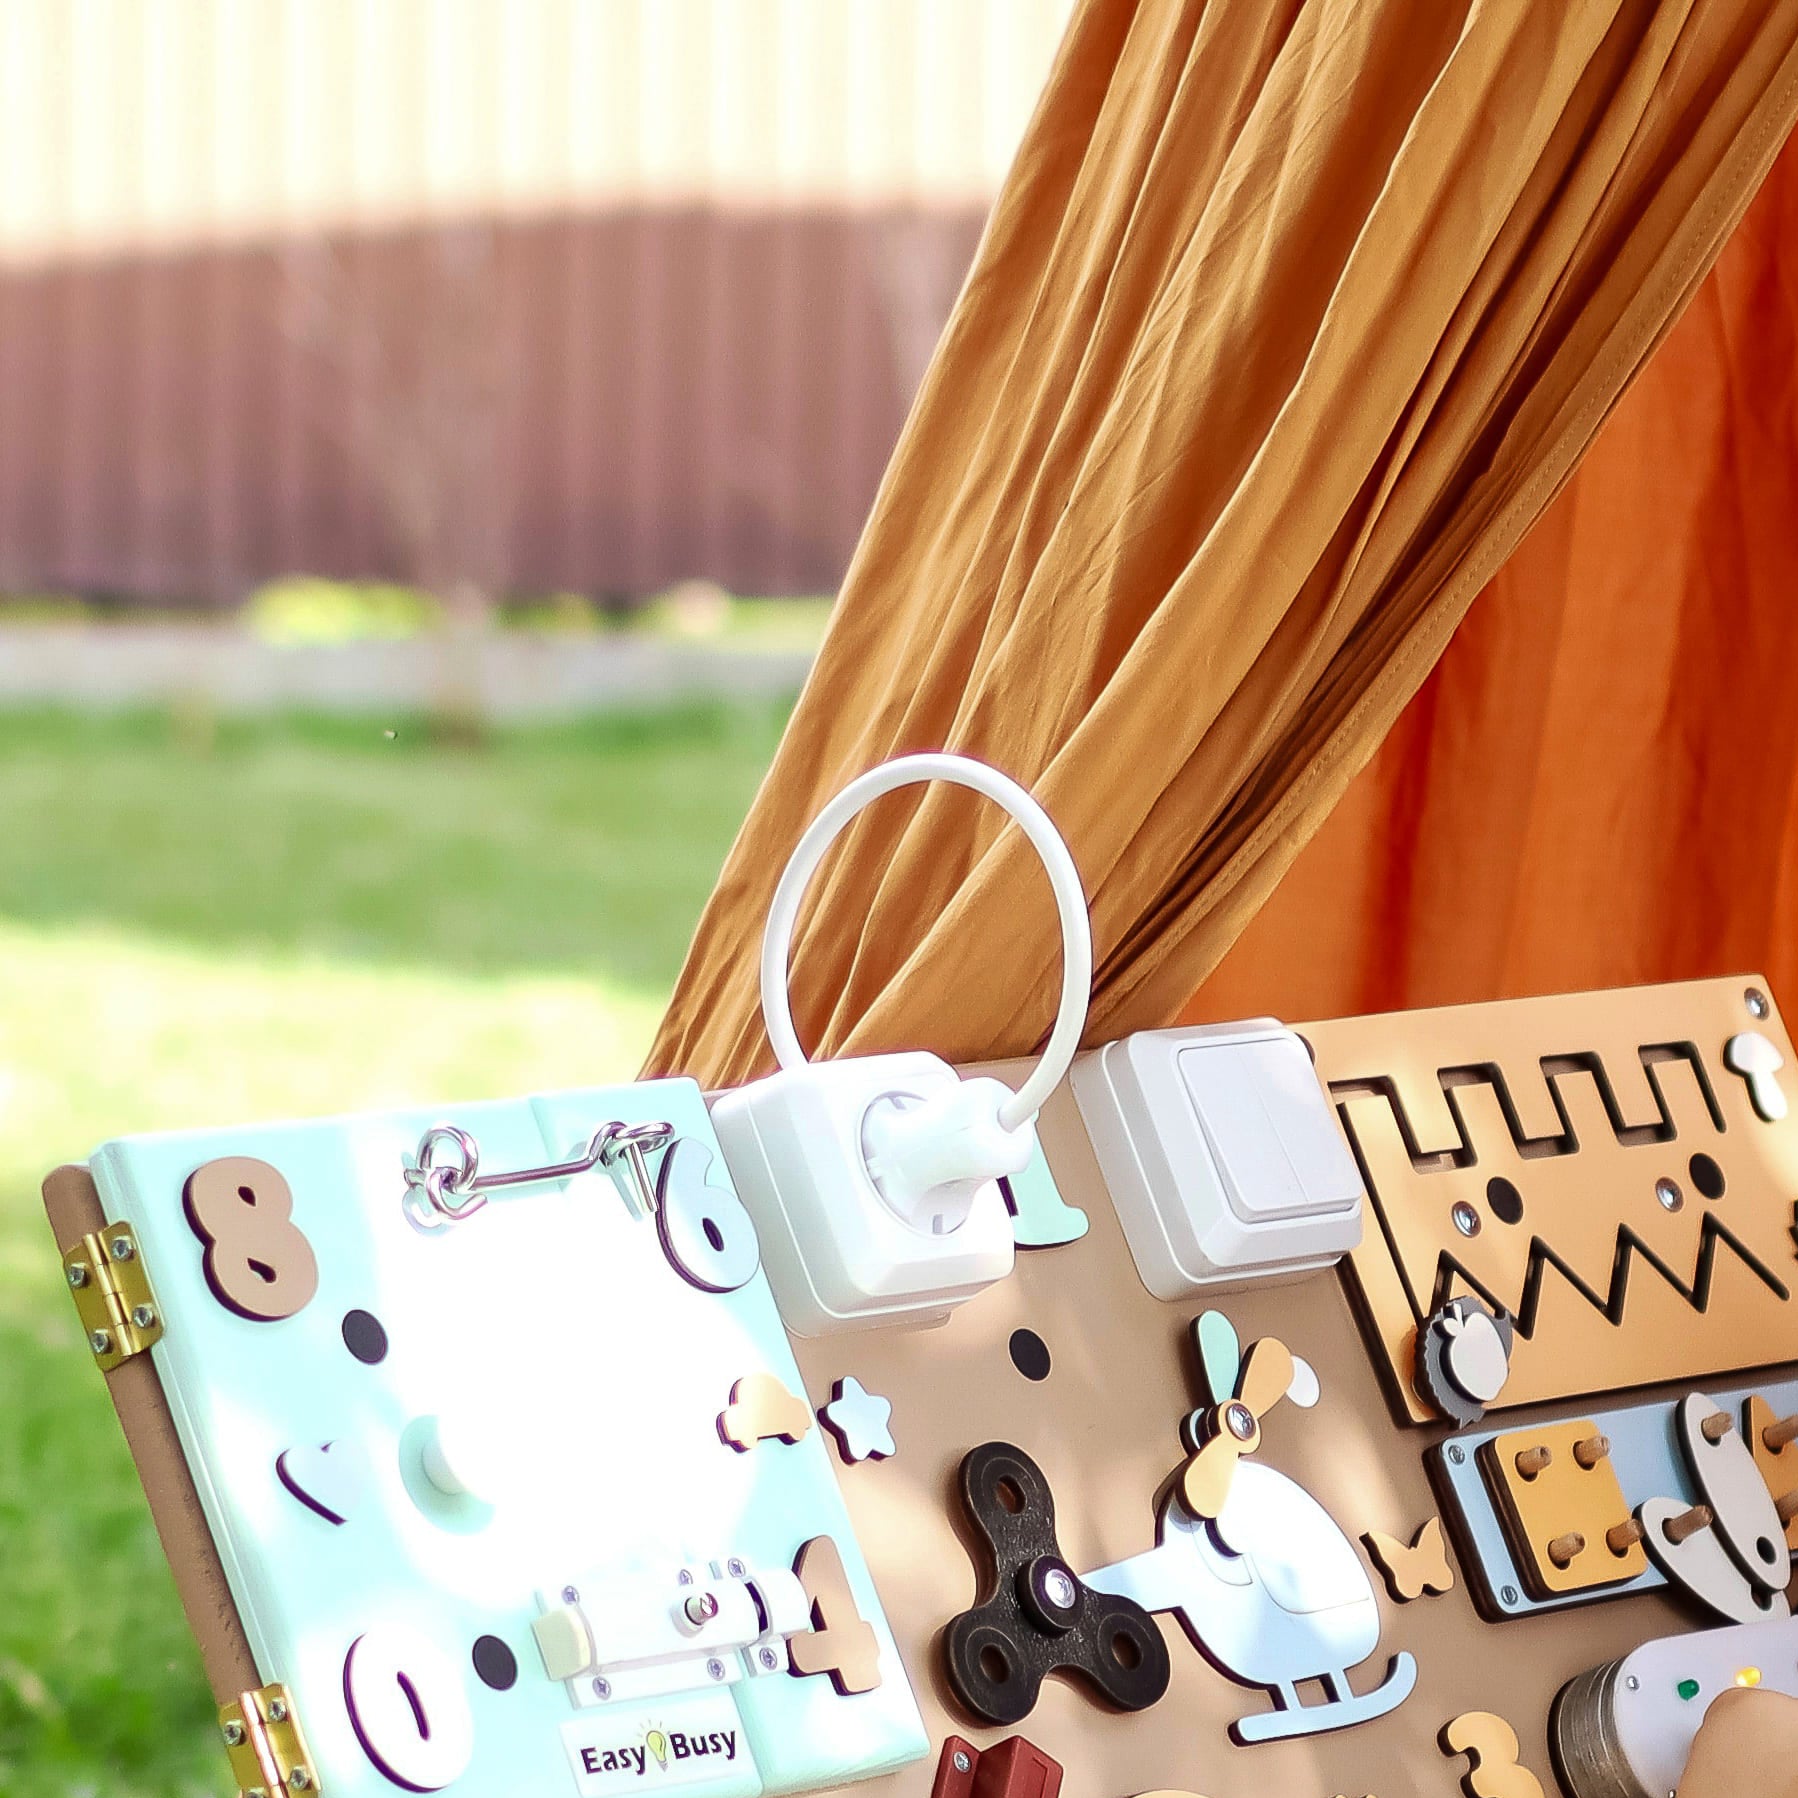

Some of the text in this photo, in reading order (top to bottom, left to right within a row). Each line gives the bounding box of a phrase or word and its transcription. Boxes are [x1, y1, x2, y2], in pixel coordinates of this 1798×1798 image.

[183, 1157, 318, 1321] 8
[656, 1138, 760, 1292] 6
[786, 1534, 881, 1696] 4
[580, 1730, 736, 1775] Easy Busy
